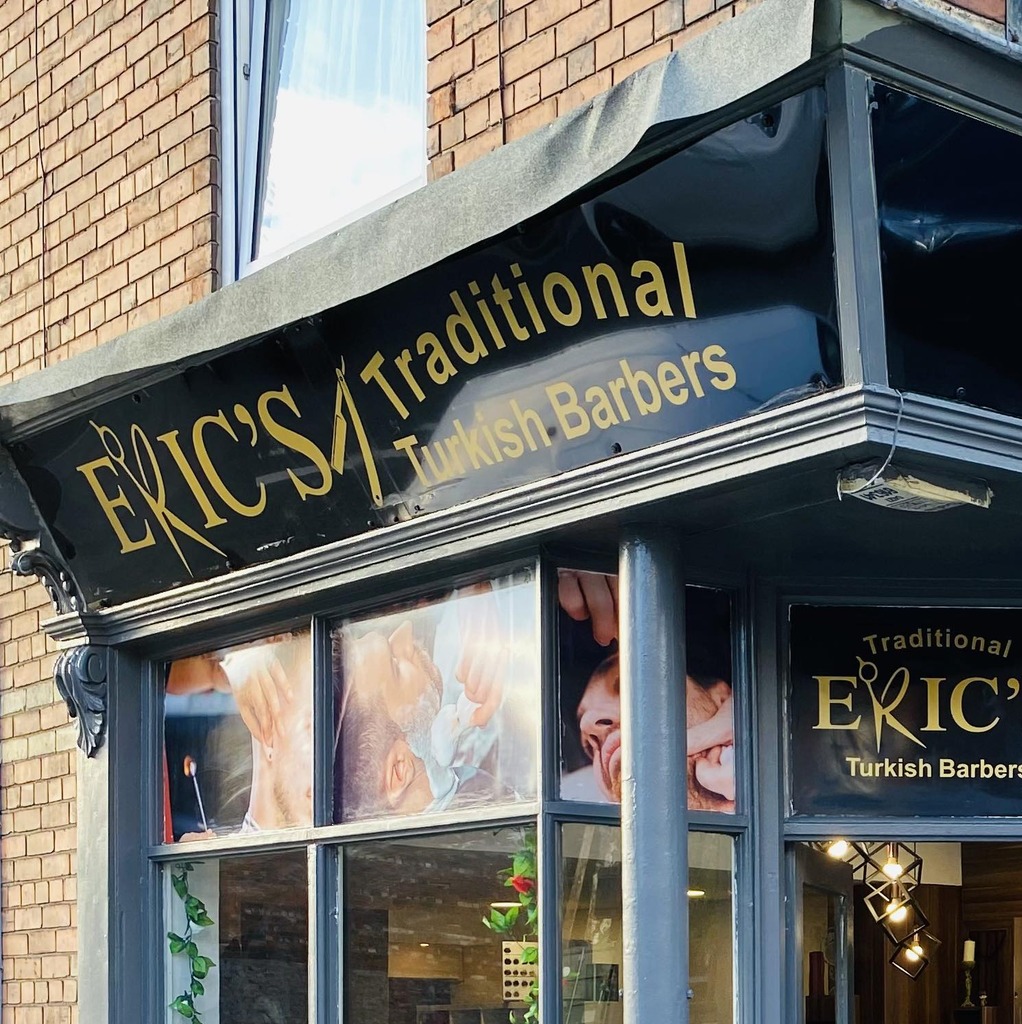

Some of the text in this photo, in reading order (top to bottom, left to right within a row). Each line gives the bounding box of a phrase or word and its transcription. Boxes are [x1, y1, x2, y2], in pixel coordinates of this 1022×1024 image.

[360, 242, 697, 420] Traditional
[76, 384, 333, 578] ERIC'S
[392, 344, 737, 487] Turkish Barbers
[862, 628, 1012, 658] Traditional
[845, 757, 932, 778] Turkish
